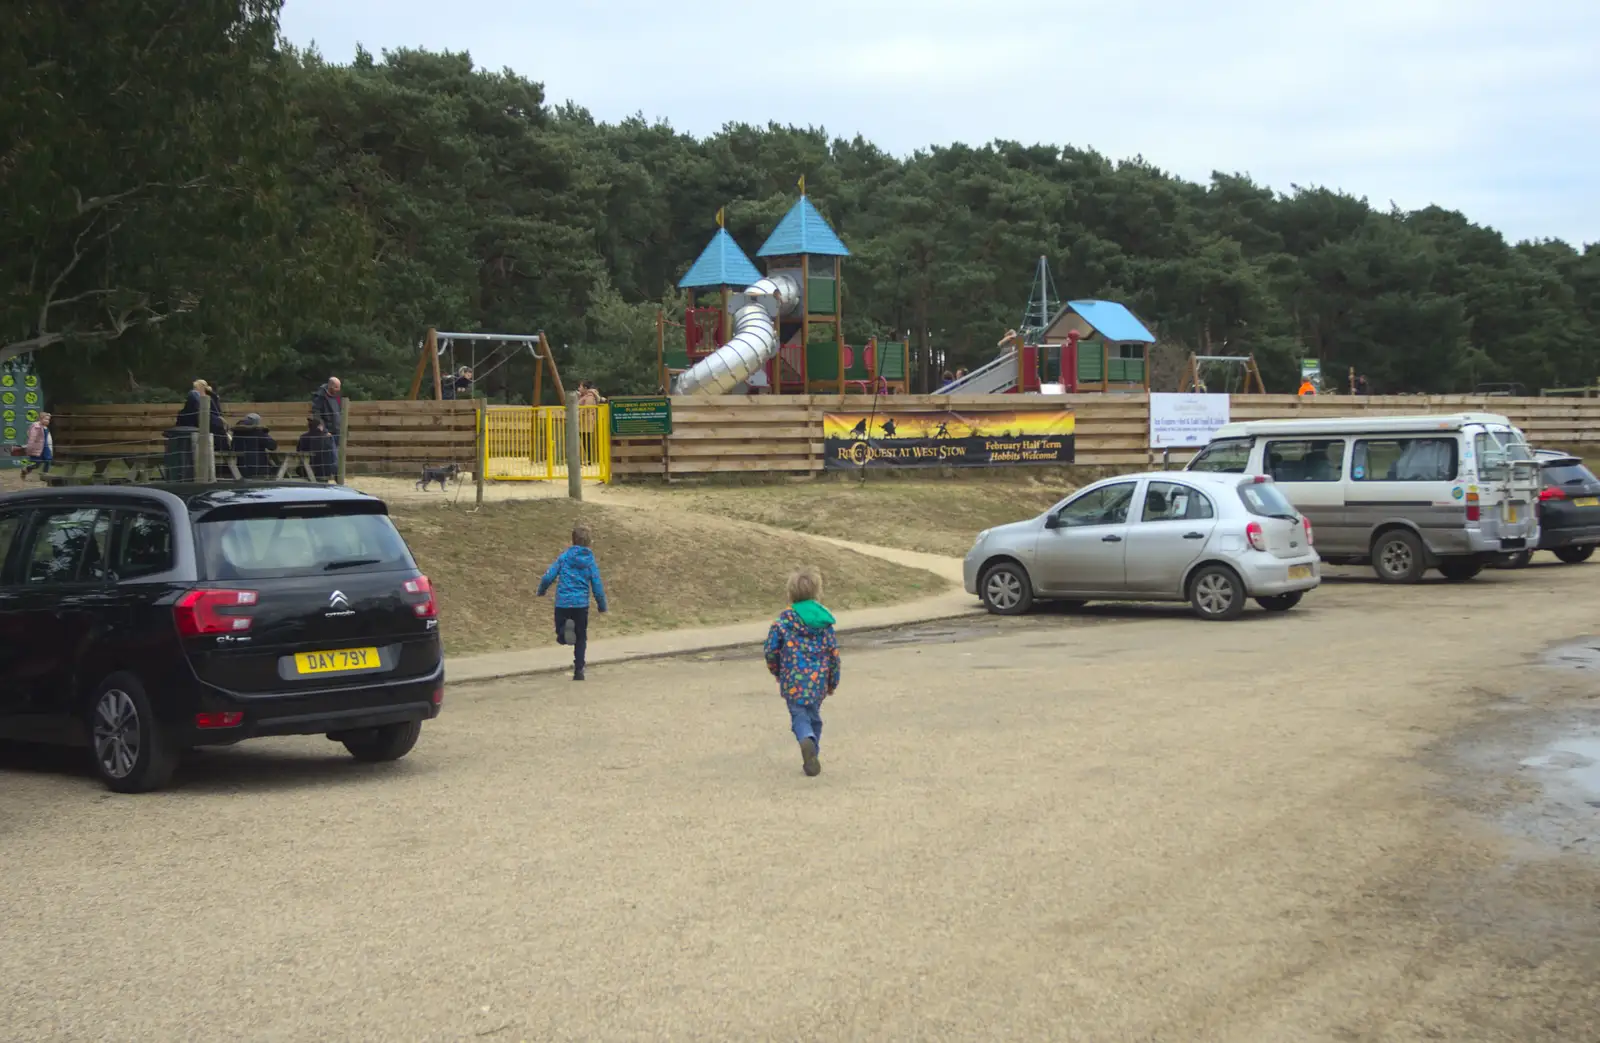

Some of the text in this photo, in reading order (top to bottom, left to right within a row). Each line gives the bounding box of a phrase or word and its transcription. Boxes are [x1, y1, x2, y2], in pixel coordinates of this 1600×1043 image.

[864, 446, 896, 460] QUEST
[899, 447, 911, 458] AT
[912, 446, 937, 458] WEST
[939, 445, 967, 459] STOW
[985, 440, 1062, 452] February Half Term
[991, 450, 1058, 461] Hobbits Welcome!
[307, 650, 367, 670] DAY 79Y
